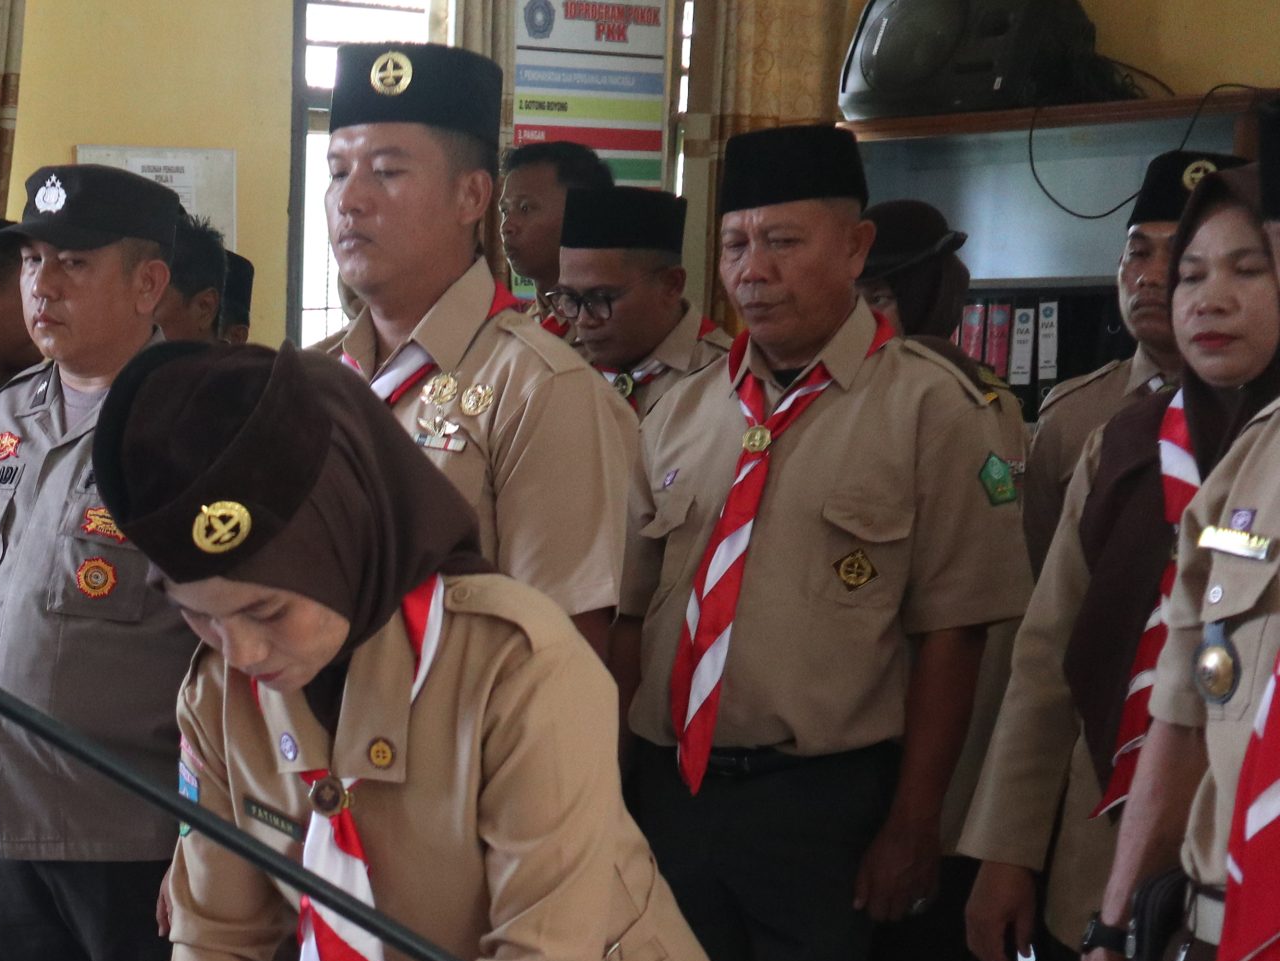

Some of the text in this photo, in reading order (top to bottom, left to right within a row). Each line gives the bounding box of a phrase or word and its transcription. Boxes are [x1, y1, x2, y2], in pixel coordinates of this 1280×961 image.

[576, 1, 625, 22] PROGRAM
[595, 22, 629, 43] PKK
[1016, 327, 1030, 335] IVA
[1041, 321, 1055, 329] IVA
